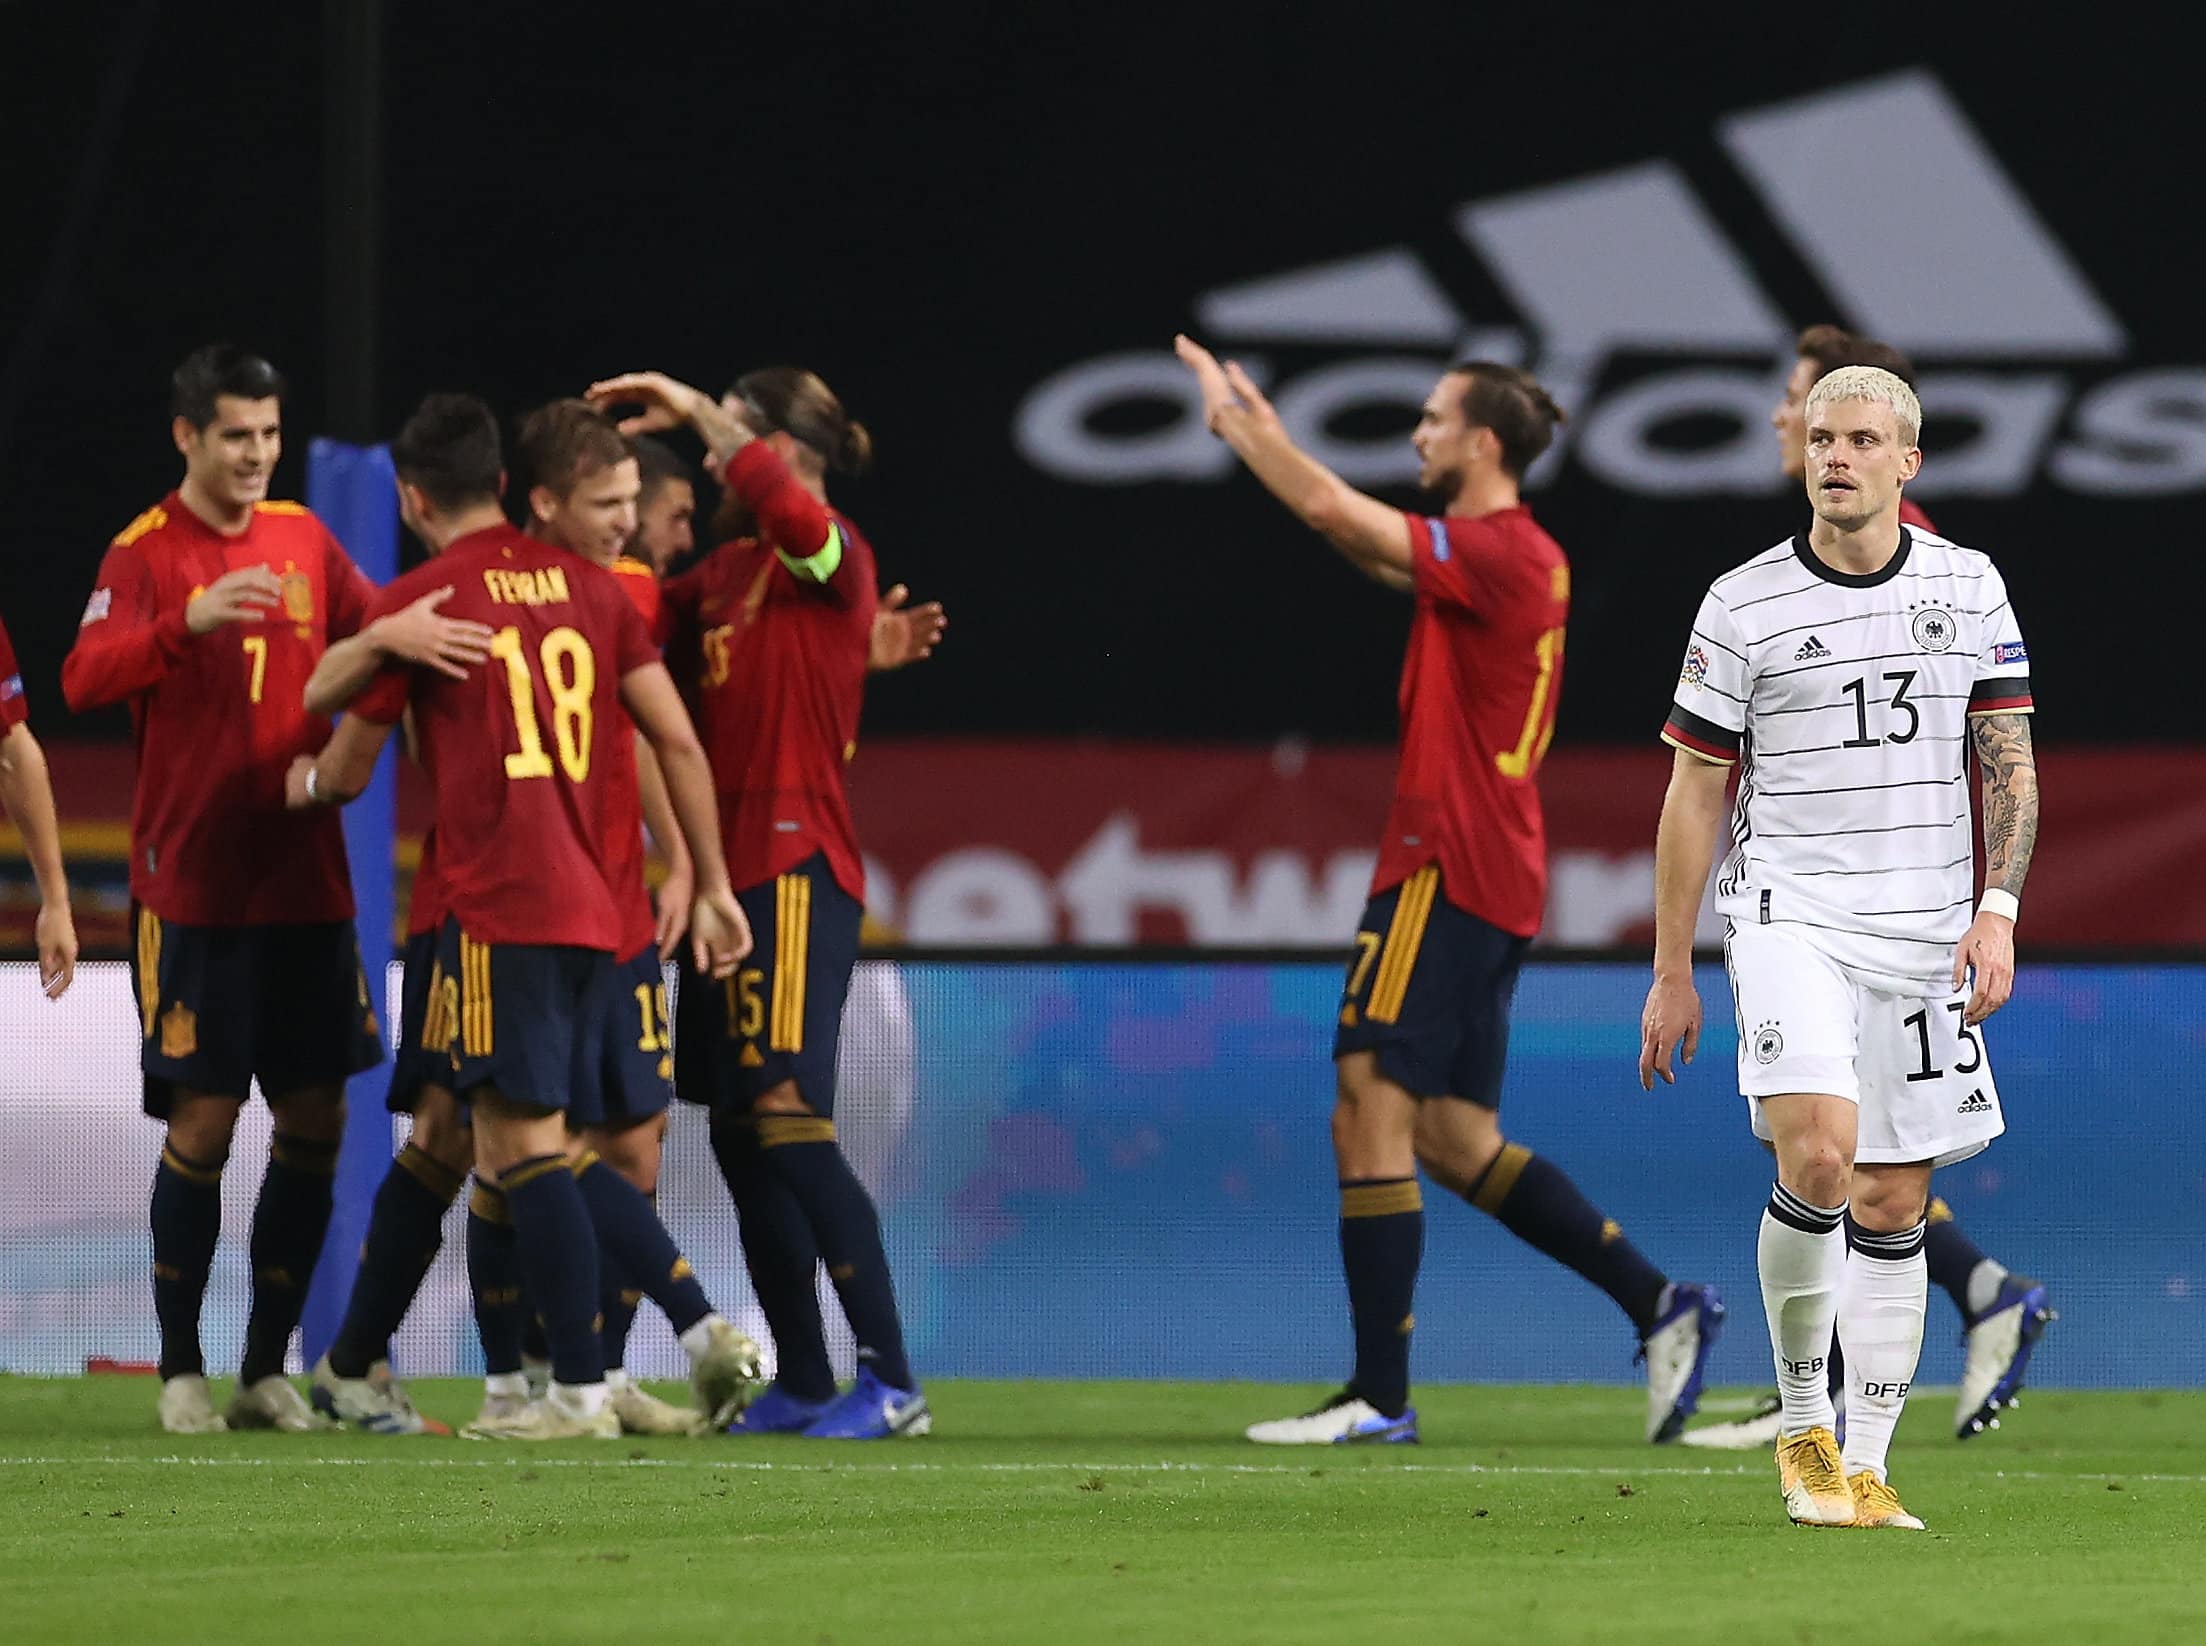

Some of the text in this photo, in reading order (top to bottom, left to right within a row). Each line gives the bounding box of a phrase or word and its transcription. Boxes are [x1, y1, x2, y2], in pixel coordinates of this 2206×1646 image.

[243, 636, 267, 703] 7
[1794, 649, 1832, 661] adidas
[490, 626, 596, 784] 18
[1842, 670, 1919, 748] 13
[1903, 1001, 1981, 1082] 13
[1957, 1103, 1993, 1114] adidas
[1781, 1356, 1824, 1375] DFB
[1864, 1382, 1910, 1398] DFB
